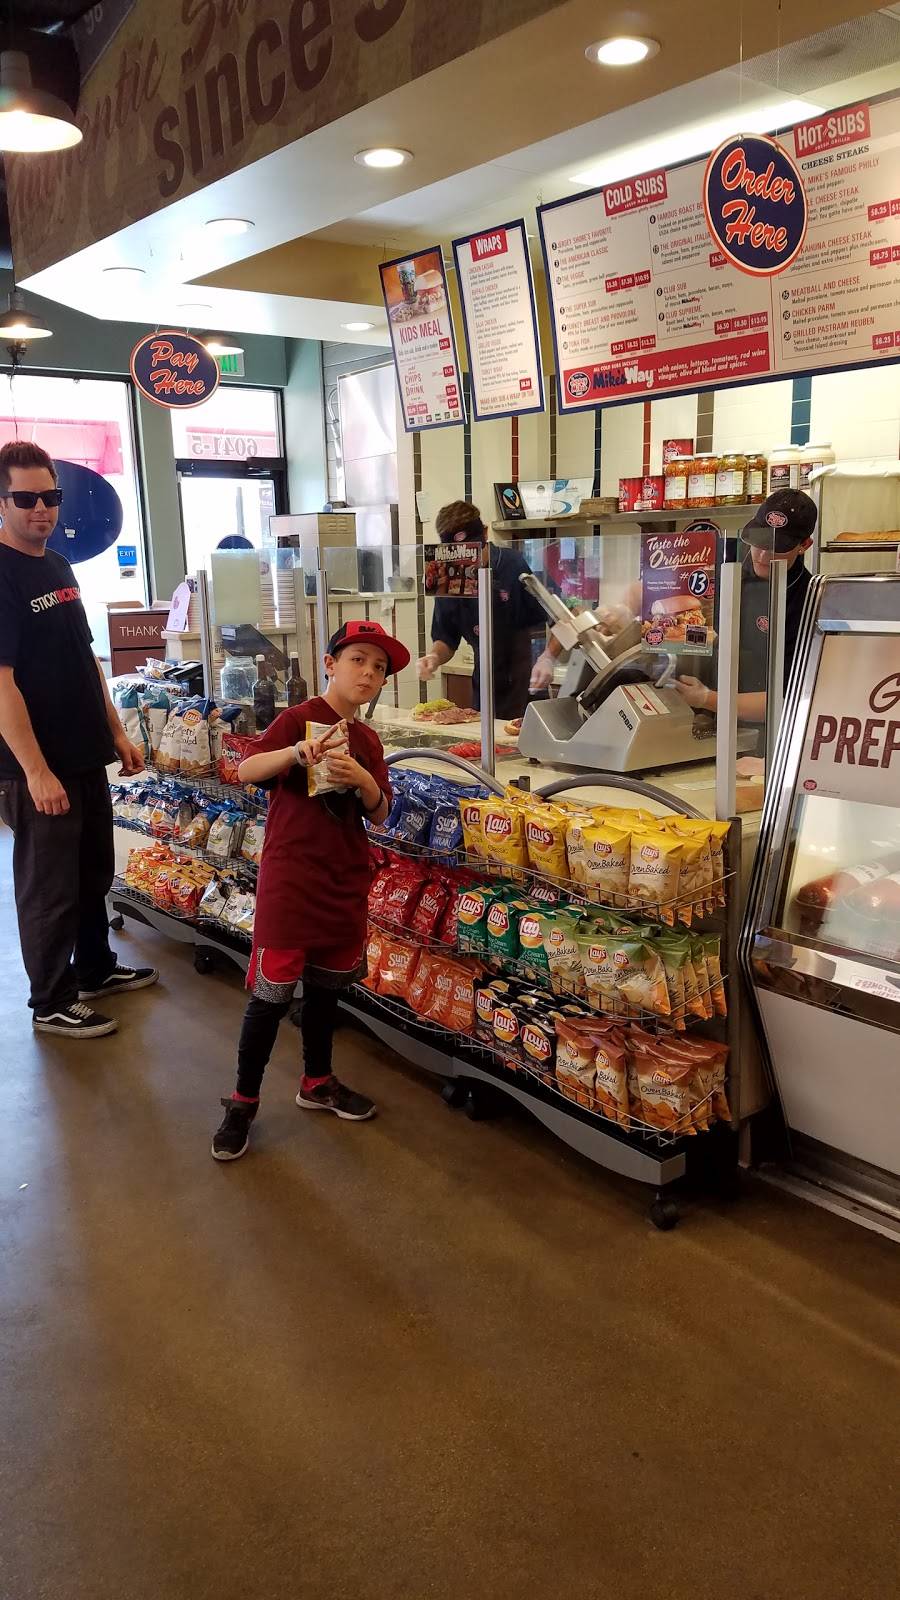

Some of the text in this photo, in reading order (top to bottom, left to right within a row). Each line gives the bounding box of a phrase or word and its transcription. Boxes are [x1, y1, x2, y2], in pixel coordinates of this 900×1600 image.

[153, 0, 334, 198] since
[797, 110, 866, 150] HOT SUBS
[801, 144, 870, 171] CHEESE STEAKS
[721, 147, 796, 205] Order
[807, 156, 880, 184] MIKE'S FAMOUS PHILLY
[605, 174, 665, 210] COLD SUBS
[815, 186, 859, 205] CHEESE STEAK
[678, 204, 695, 217] ROAST
[721, 198, 788, 253] Here
[475, 234, 502, 257] WRAPS
[660, 236, 693, 251] THE ORIGINAL
[827, 234, 850, 249] CHEESE
[851, 230, 872, 242] STEAK
[568, 251, 590, 263] AMERICAN
[590, 245, 609, 257] CLASSIC
[663, 282, 687, 294] CLUB SUB
[790, 275, 861, 298] MEATBALL AND CHEESE
[583, 317, 600, 327] BREAST
[600, 314, 610, 322] AND
[665, 304, 703, 320] CLUB SUPREME
[791, 302, 836, 318] CHICKEN PARM
[400, 318, 444, 346] KIDS MEAL
[792, 316, 875, 339] GRILLED PASTRAMI REUBEN
[149, 340, 200, 375] Pay
[657, 364, 670, 373] with
[711, 353, 739, 364] tomatoes,
[740, 350, 751, 359] red
[751, 348, 766, 357] wine
[404, 373, 422, 385] CHIPS
[679, 368, 693, 377] olive
[717, 362, 729, 370] and
[149, 368, 206, 396] Here
[405, 384, 425, 397] DRINK
[119, 550, 136, 558] EXIT
[646, 535, 690, 552] Taste the
[648, 545, 712, 572] Original!
[119, 625, 159, 637] THANK
[435, 816, 458, 832] Sun
[486, 814, 512, 836] Lay's
[528, 823, 554, 847] Lay's
[493, 1011, 516, 1033] Lay's
[523, 1029, 549, 1053] Lay's
